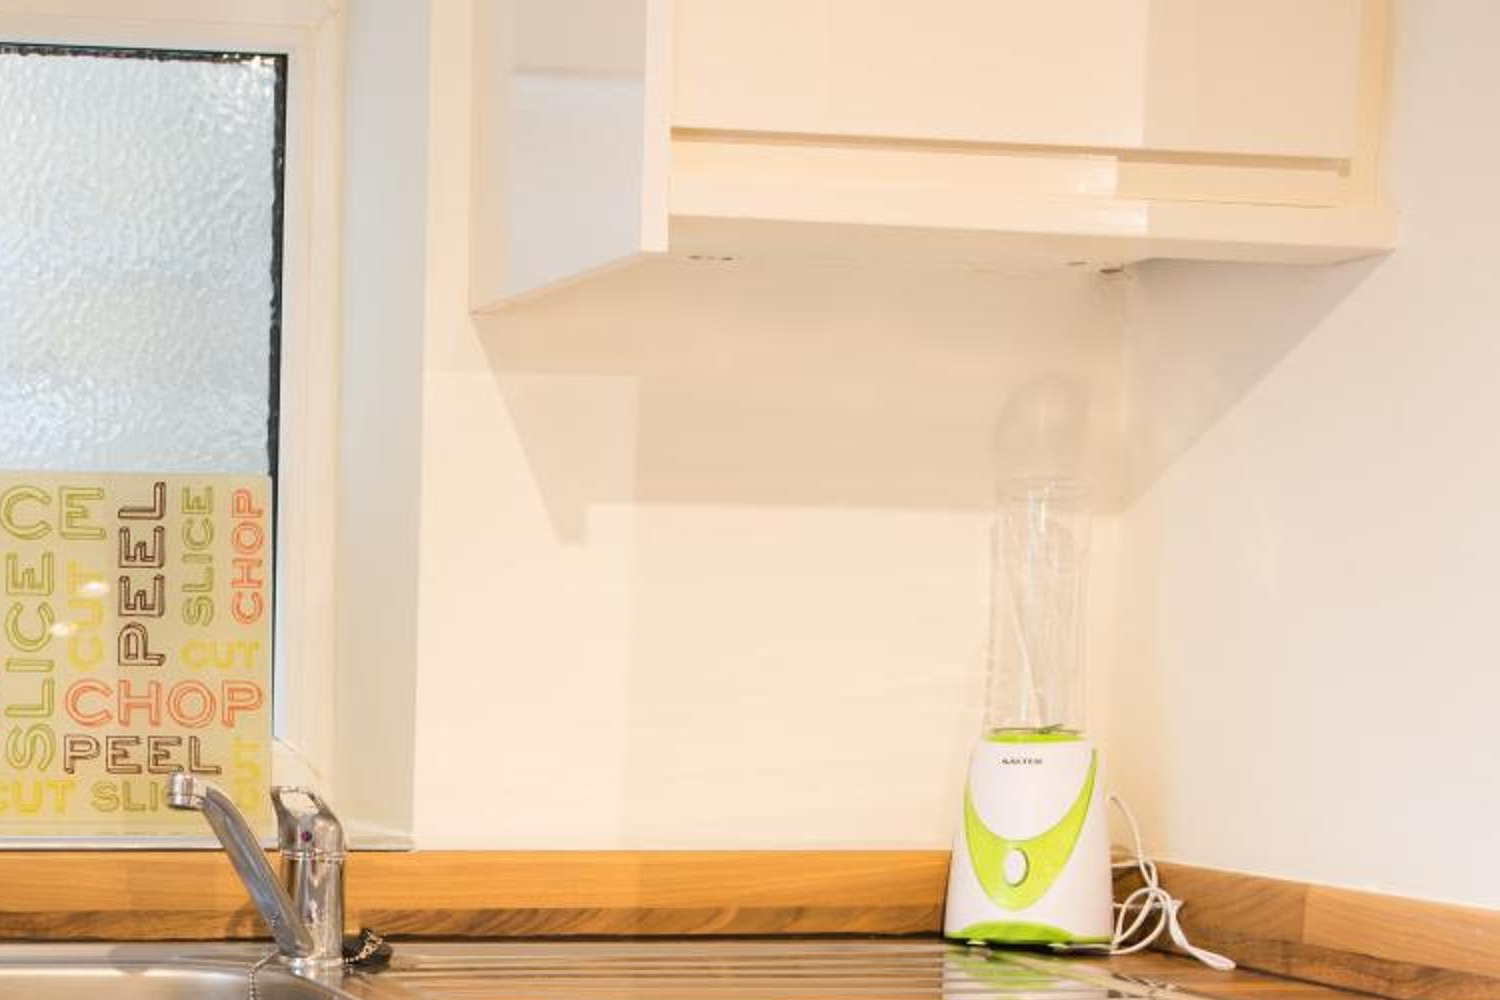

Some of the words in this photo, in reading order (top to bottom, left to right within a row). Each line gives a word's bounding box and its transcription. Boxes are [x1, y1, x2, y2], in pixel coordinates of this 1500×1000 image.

[117, 481, 166, 667] PEEL
[181, 485, 216, 627] SLICE
[231, 487, 265, 625] CHOP
[4, 551, 57, 772] SLICE
[66, 559, 107, 671] CUT
[179, 640, 261, 671] CUT
[63, 734, 222, 775] PEEL
[64, 678, 264, 730] CHOP
[90, 780, 170, 812] SLI
